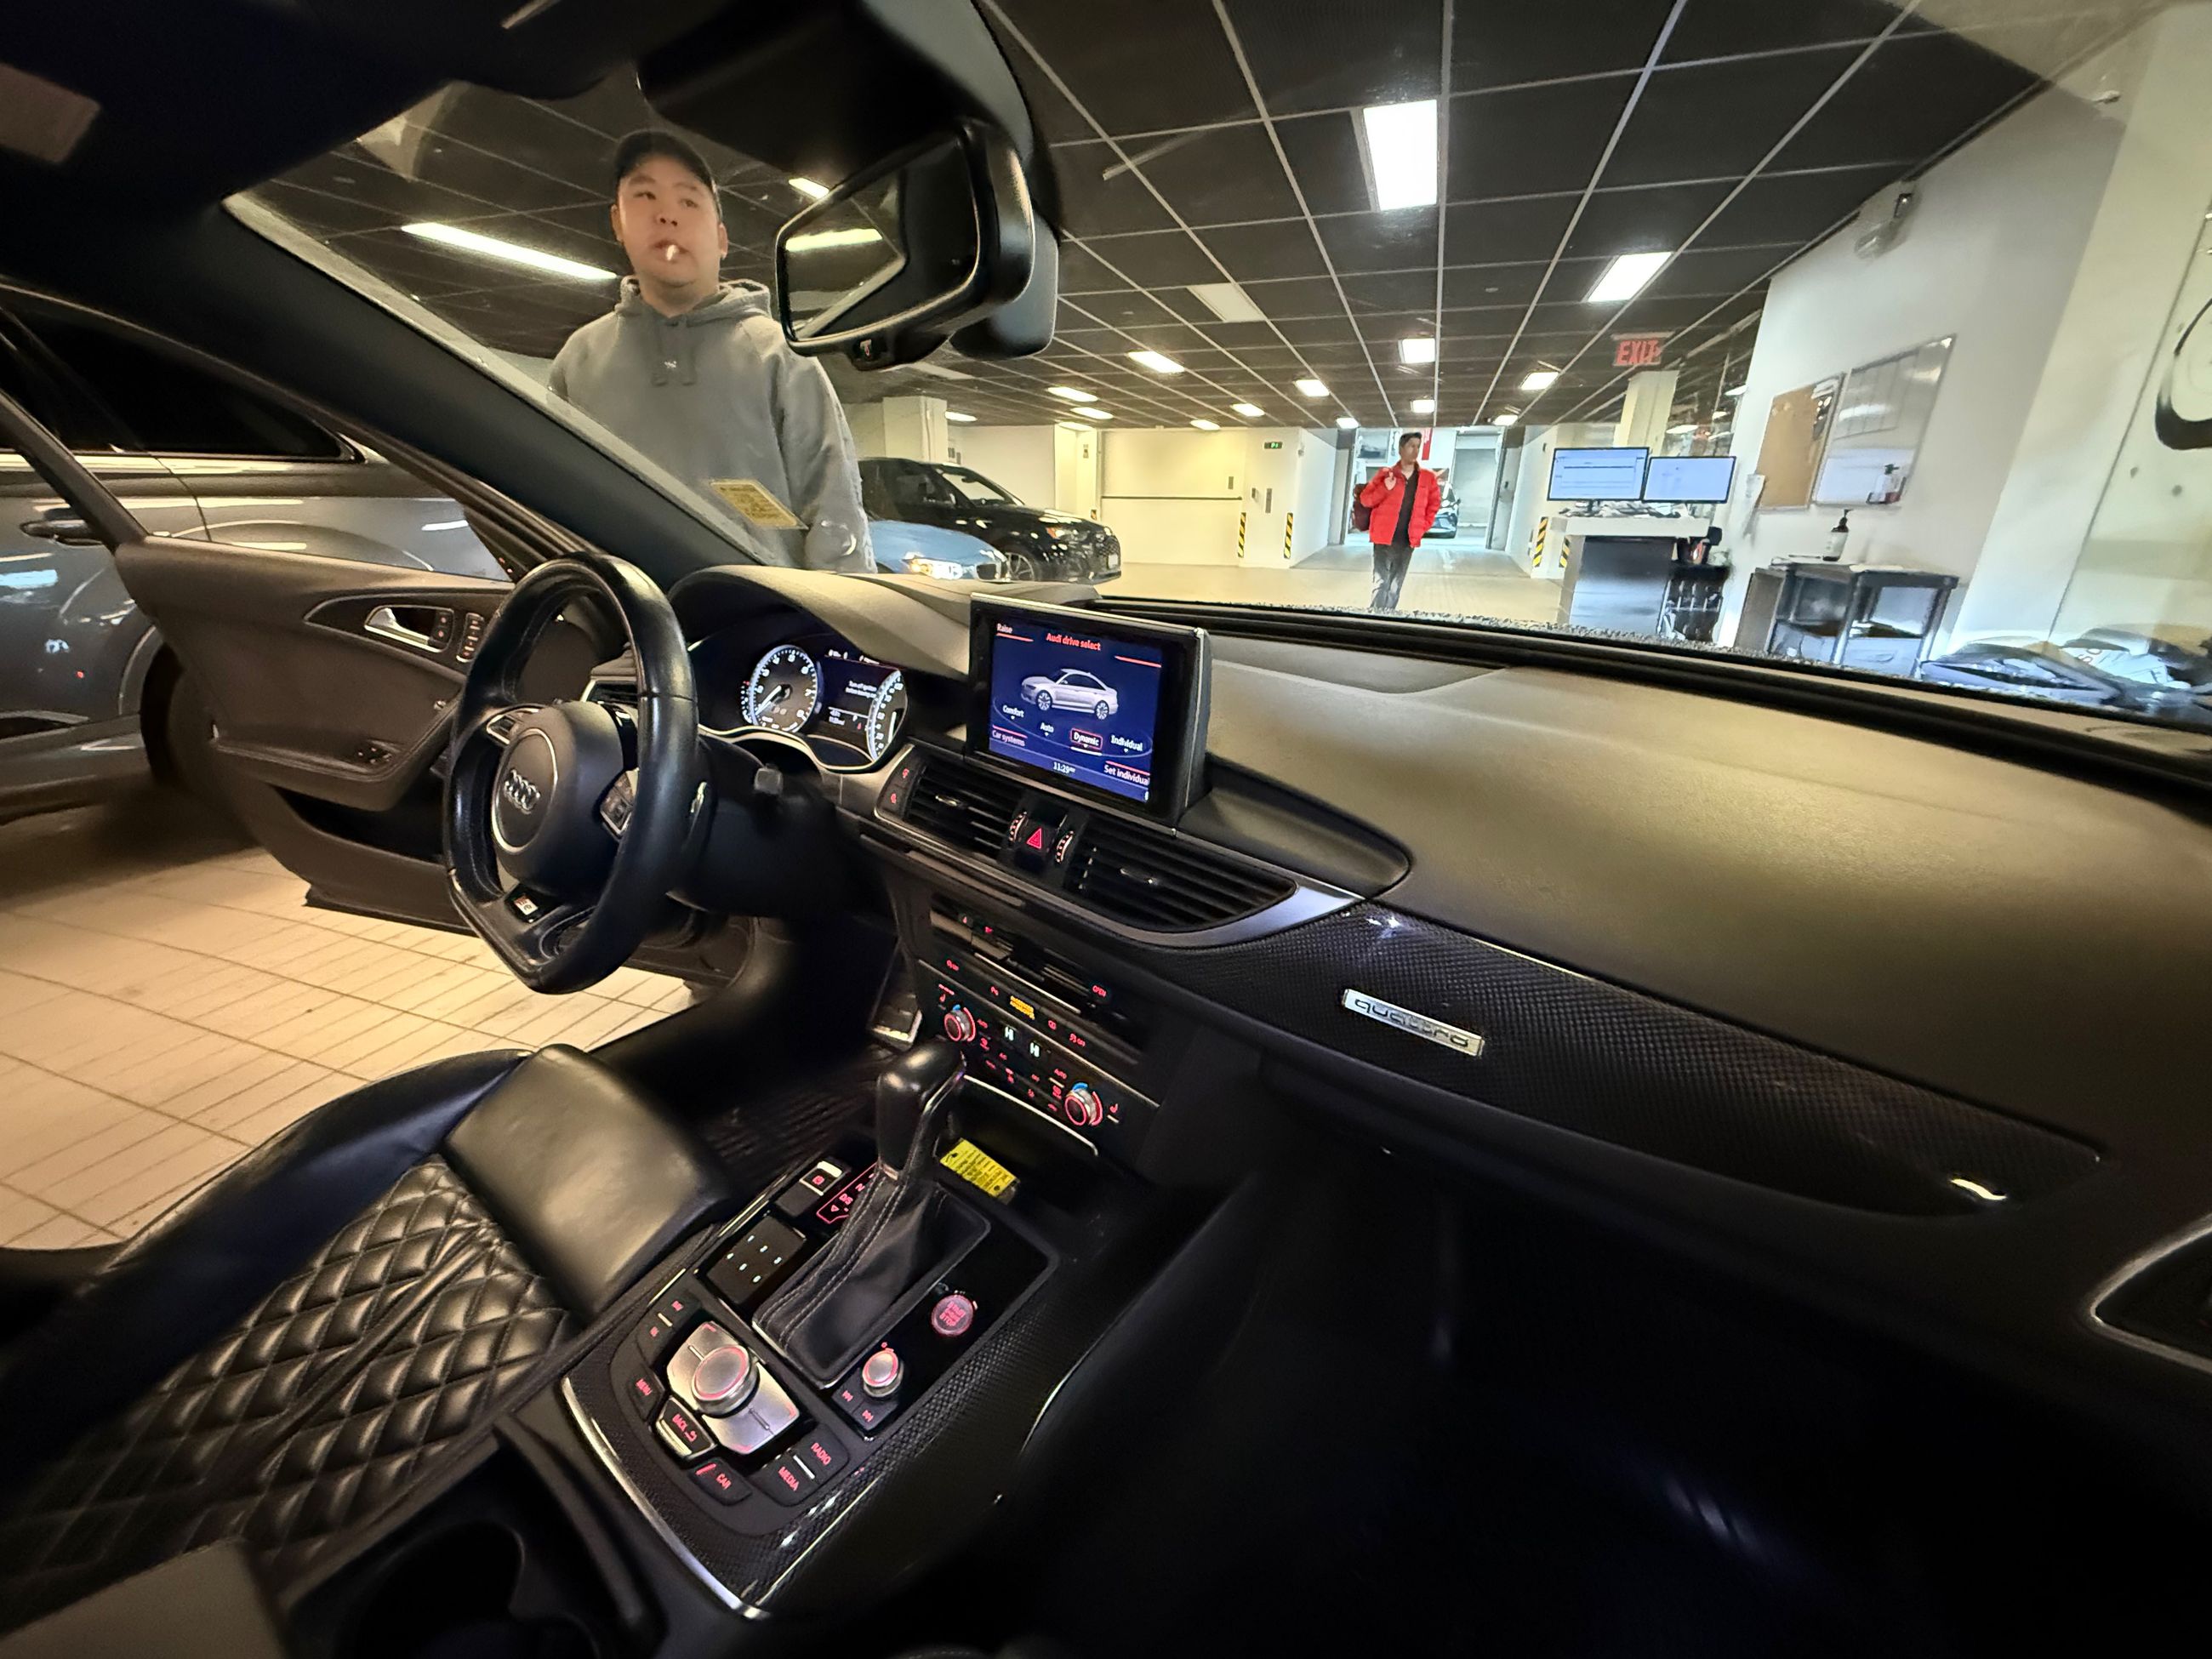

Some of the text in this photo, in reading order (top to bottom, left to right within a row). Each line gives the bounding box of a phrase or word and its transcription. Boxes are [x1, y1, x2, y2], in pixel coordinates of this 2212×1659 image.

[1616, 339, 1658, 364] EXIT
[1046, 632, 1101, 651] Audi drive select
[1002, 704, 1024, 718] Comfort
[992, 730, 1002, 740] Car
[1040, 721, 1055, 733] Auto
[1073, 732, 1100, 746] Dynamic
[1110, 734, 1143, 752] Individual
[1103, 764, 1116, 775] Set
[671, 1413, 688, 1432] BACK
[811, 1442, 832, 1466] RADIO
[715, 1473, 732, 1490] CAR
[778, 1466, 800, 1491] MEDIA
